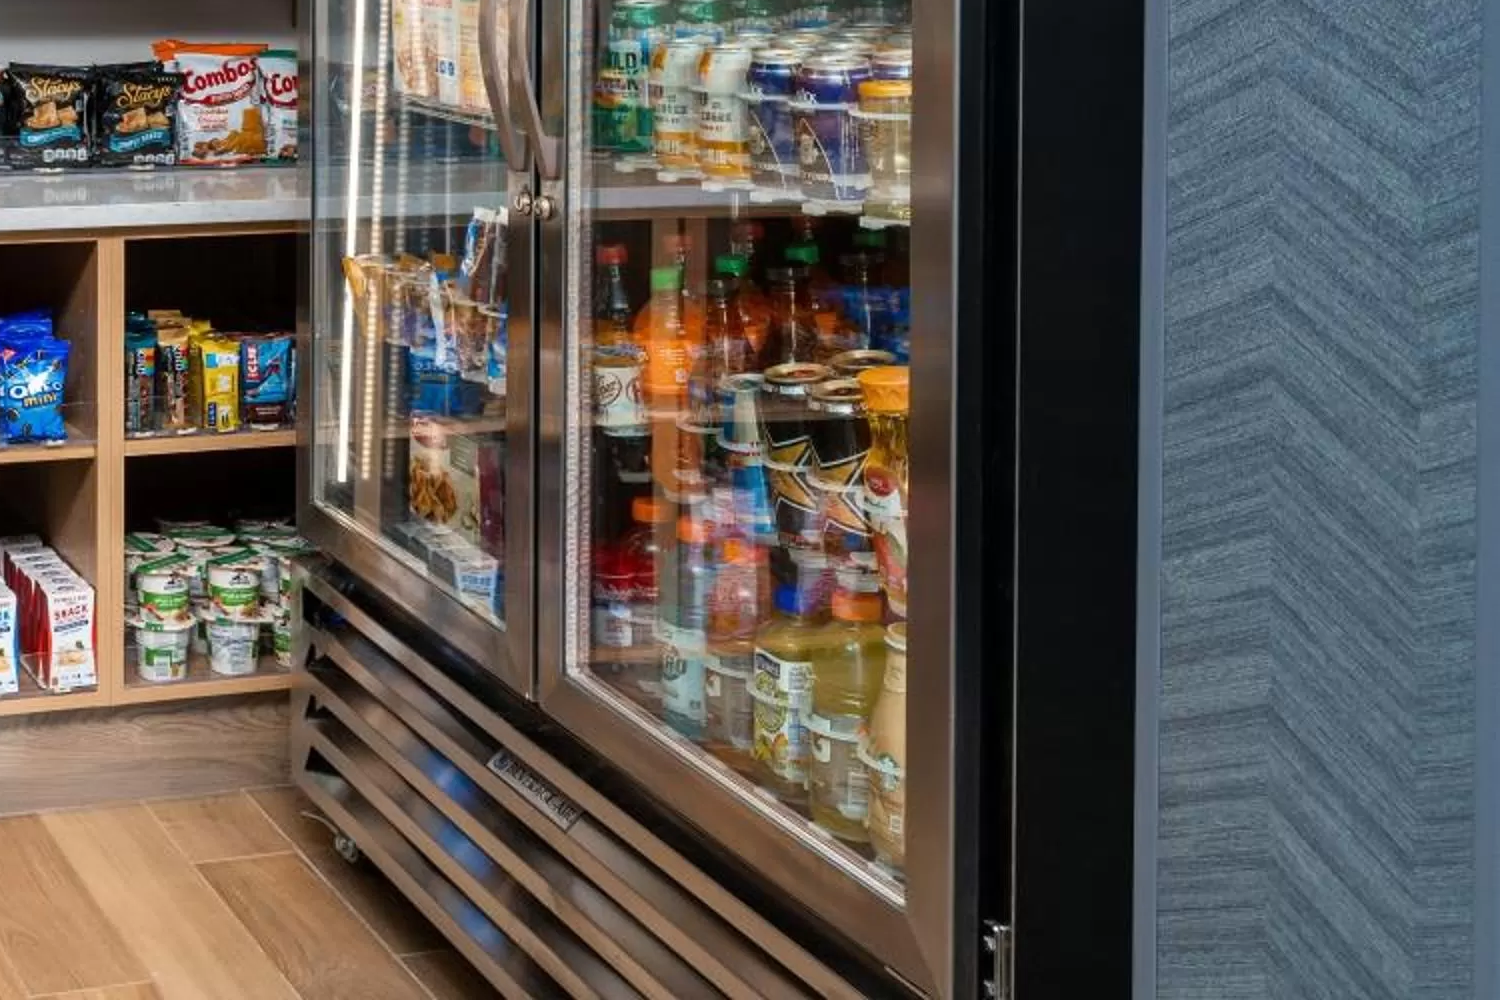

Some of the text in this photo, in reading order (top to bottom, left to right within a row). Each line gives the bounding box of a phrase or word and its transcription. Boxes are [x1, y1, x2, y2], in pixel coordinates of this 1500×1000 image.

[26, 76, 83, 103] Stacy's
[183, 57, 257, 94] Combos
[116, 81, 174, 109] Stacy's
